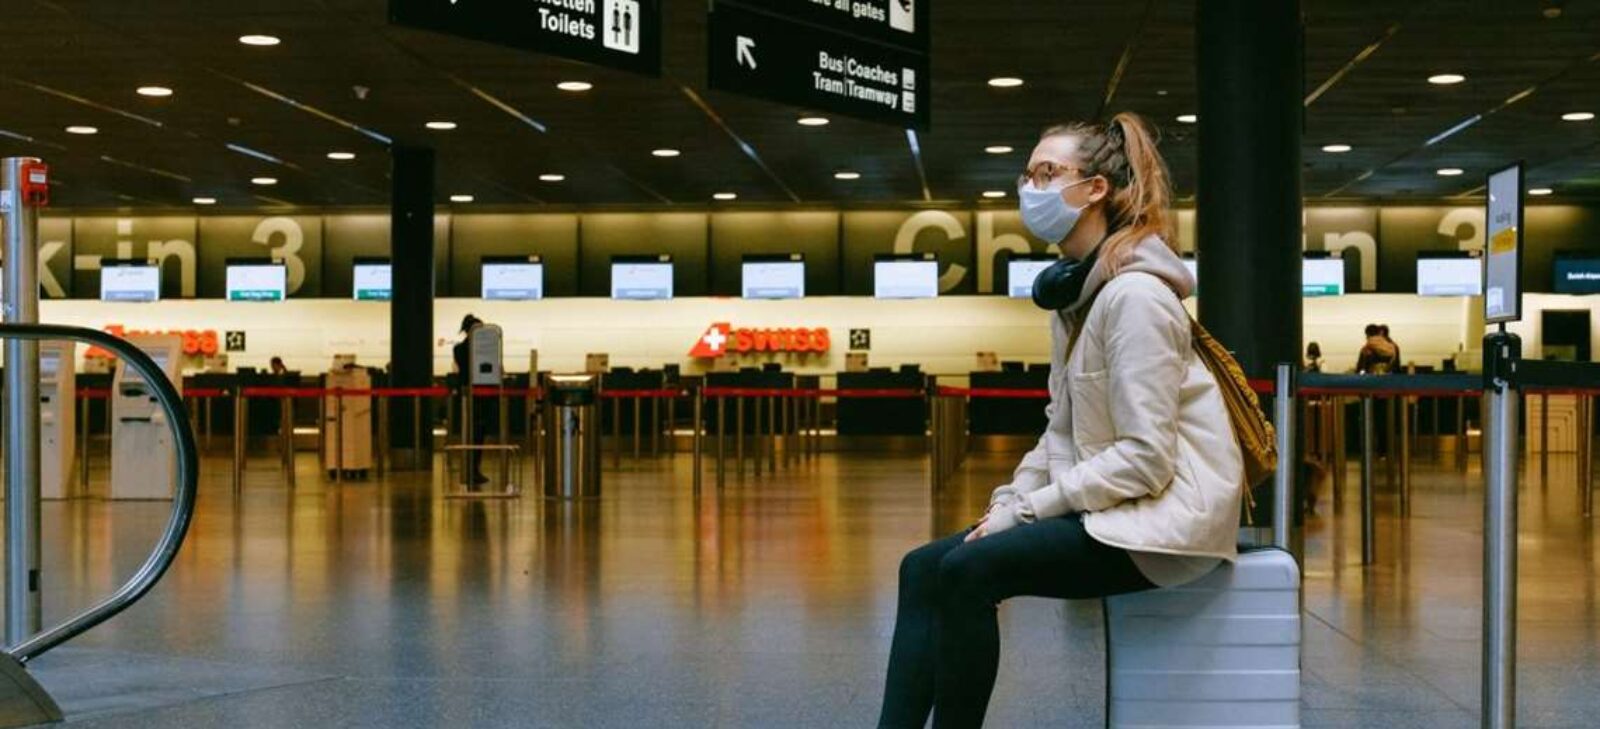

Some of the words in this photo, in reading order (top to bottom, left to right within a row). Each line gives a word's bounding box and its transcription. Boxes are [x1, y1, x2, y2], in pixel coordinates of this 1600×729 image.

[538, 7, 595, 39] Toilets
[852, 2, 885, 21] gates
[819, 51, 844, 73] Bus
[847, 58, 898, 86] Coaches
[812, 71, 843, 94] Tram
[846, 79, 899, 109] Tramway
[252, 216, 305, 296] 3
